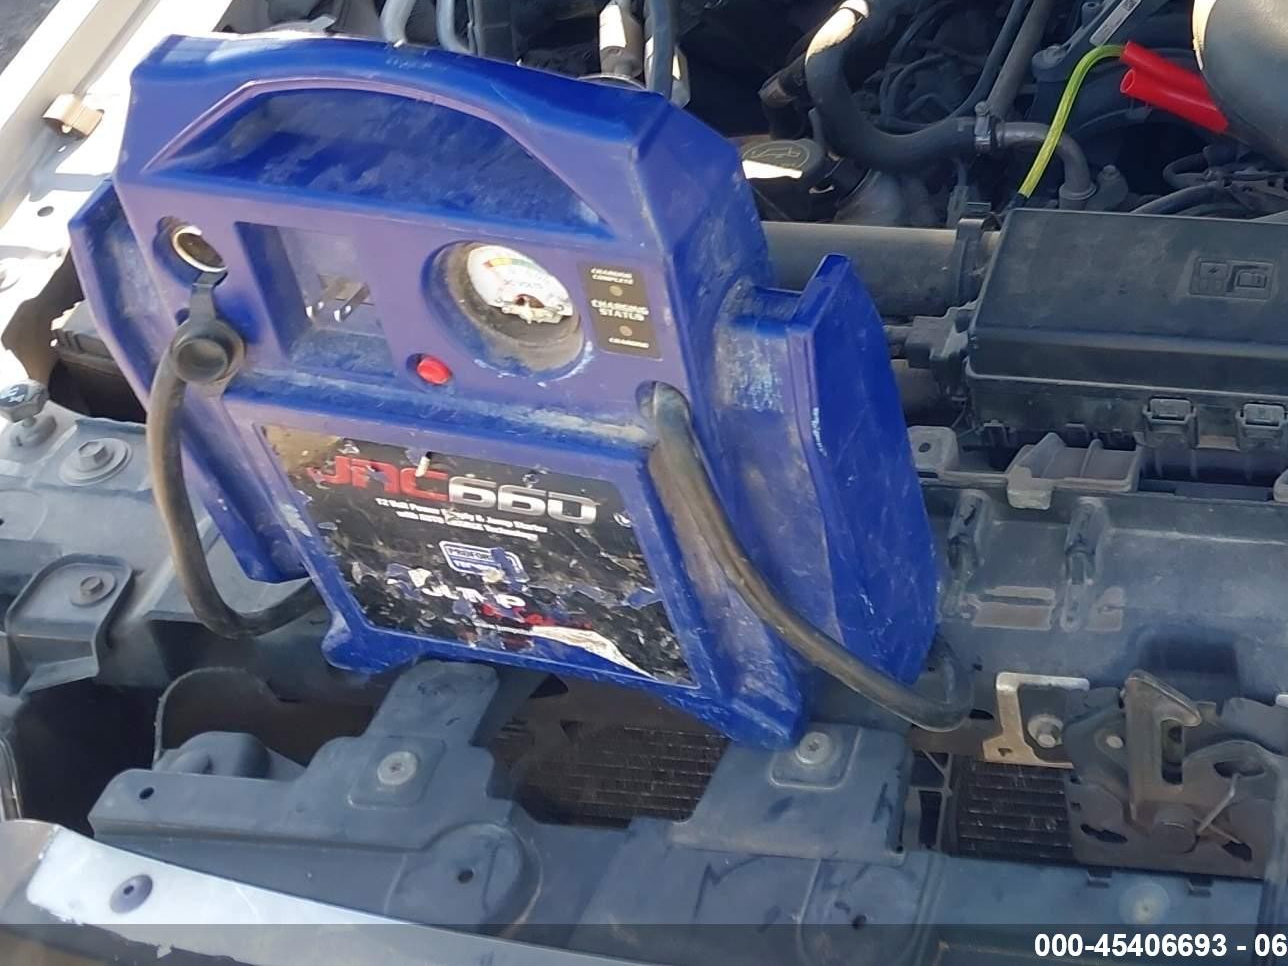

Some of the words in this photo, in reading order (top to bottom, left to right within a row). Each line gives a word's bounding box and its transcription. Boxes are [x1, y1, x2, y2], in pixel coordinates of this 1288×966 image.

[590, 299, 650, 315] CHARGING
[599, 308, 645, 322] STATUS
[307, 455, 597, 525] JNC660
